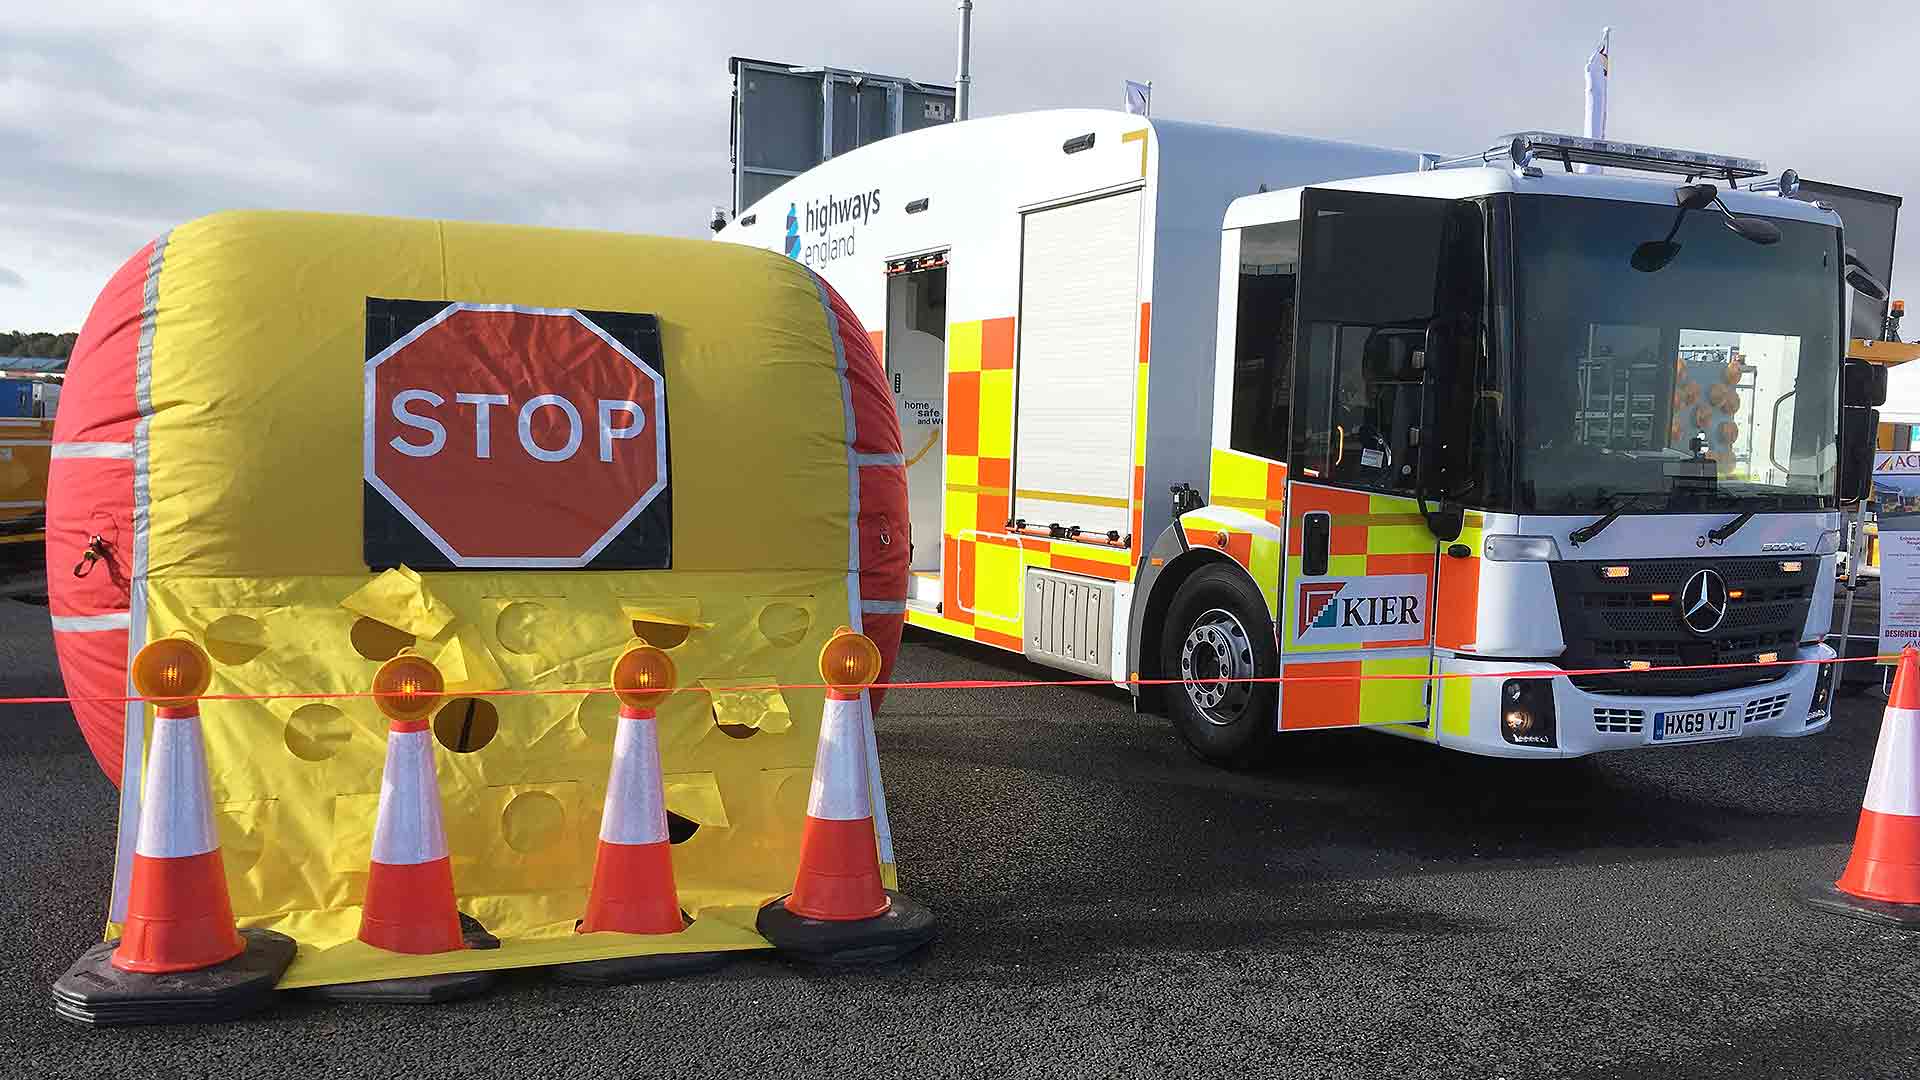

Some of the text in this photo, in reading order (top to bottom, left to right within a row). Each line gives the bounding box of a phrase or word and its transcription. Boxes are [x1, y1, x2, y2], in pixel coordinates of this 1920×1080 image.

[806, 188, 880, 237] highways
[805, 225, 855, 269] england
[904, 401, 930, 410] home
[917, 408, 940, 417] safe
[389, 389, 646, 462] STOP
[1895, 454, 1920, 468] AC
[1761, 542, 1807, 552] ECONIC
[1341, 595, 1421, 627] KIER
[1885, 630, 1918, 638] DESIGNED
[1664, 710, 1737, 735] HX69 YJT
